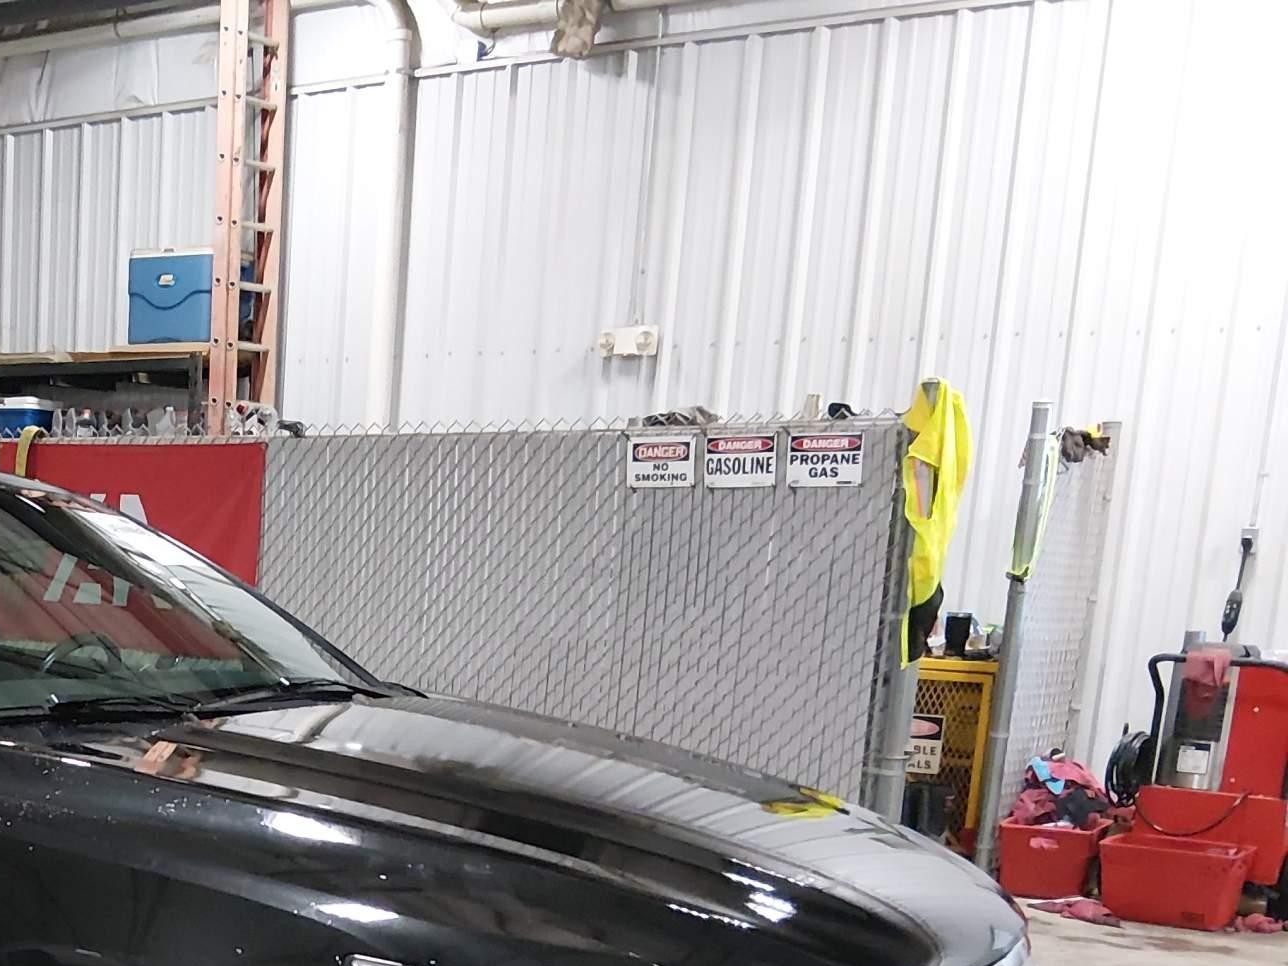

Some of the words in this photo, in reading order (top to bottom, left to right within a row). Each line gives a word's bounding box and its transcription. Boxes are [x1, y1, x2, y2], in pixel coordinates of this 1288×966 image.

[718, 440, 762, 450] DANGER
[802, 438, 849, 448] DANGER
[638, 445, 684, 459] DANGER
[789, 453, 861, 465] PROPANE
[652, 463, 669, 471] NO
[706, 456, 774, 475] GASOLINE
[634, 472, 688, 482] SMOKING
[808, 466, 839, 478] GAS
